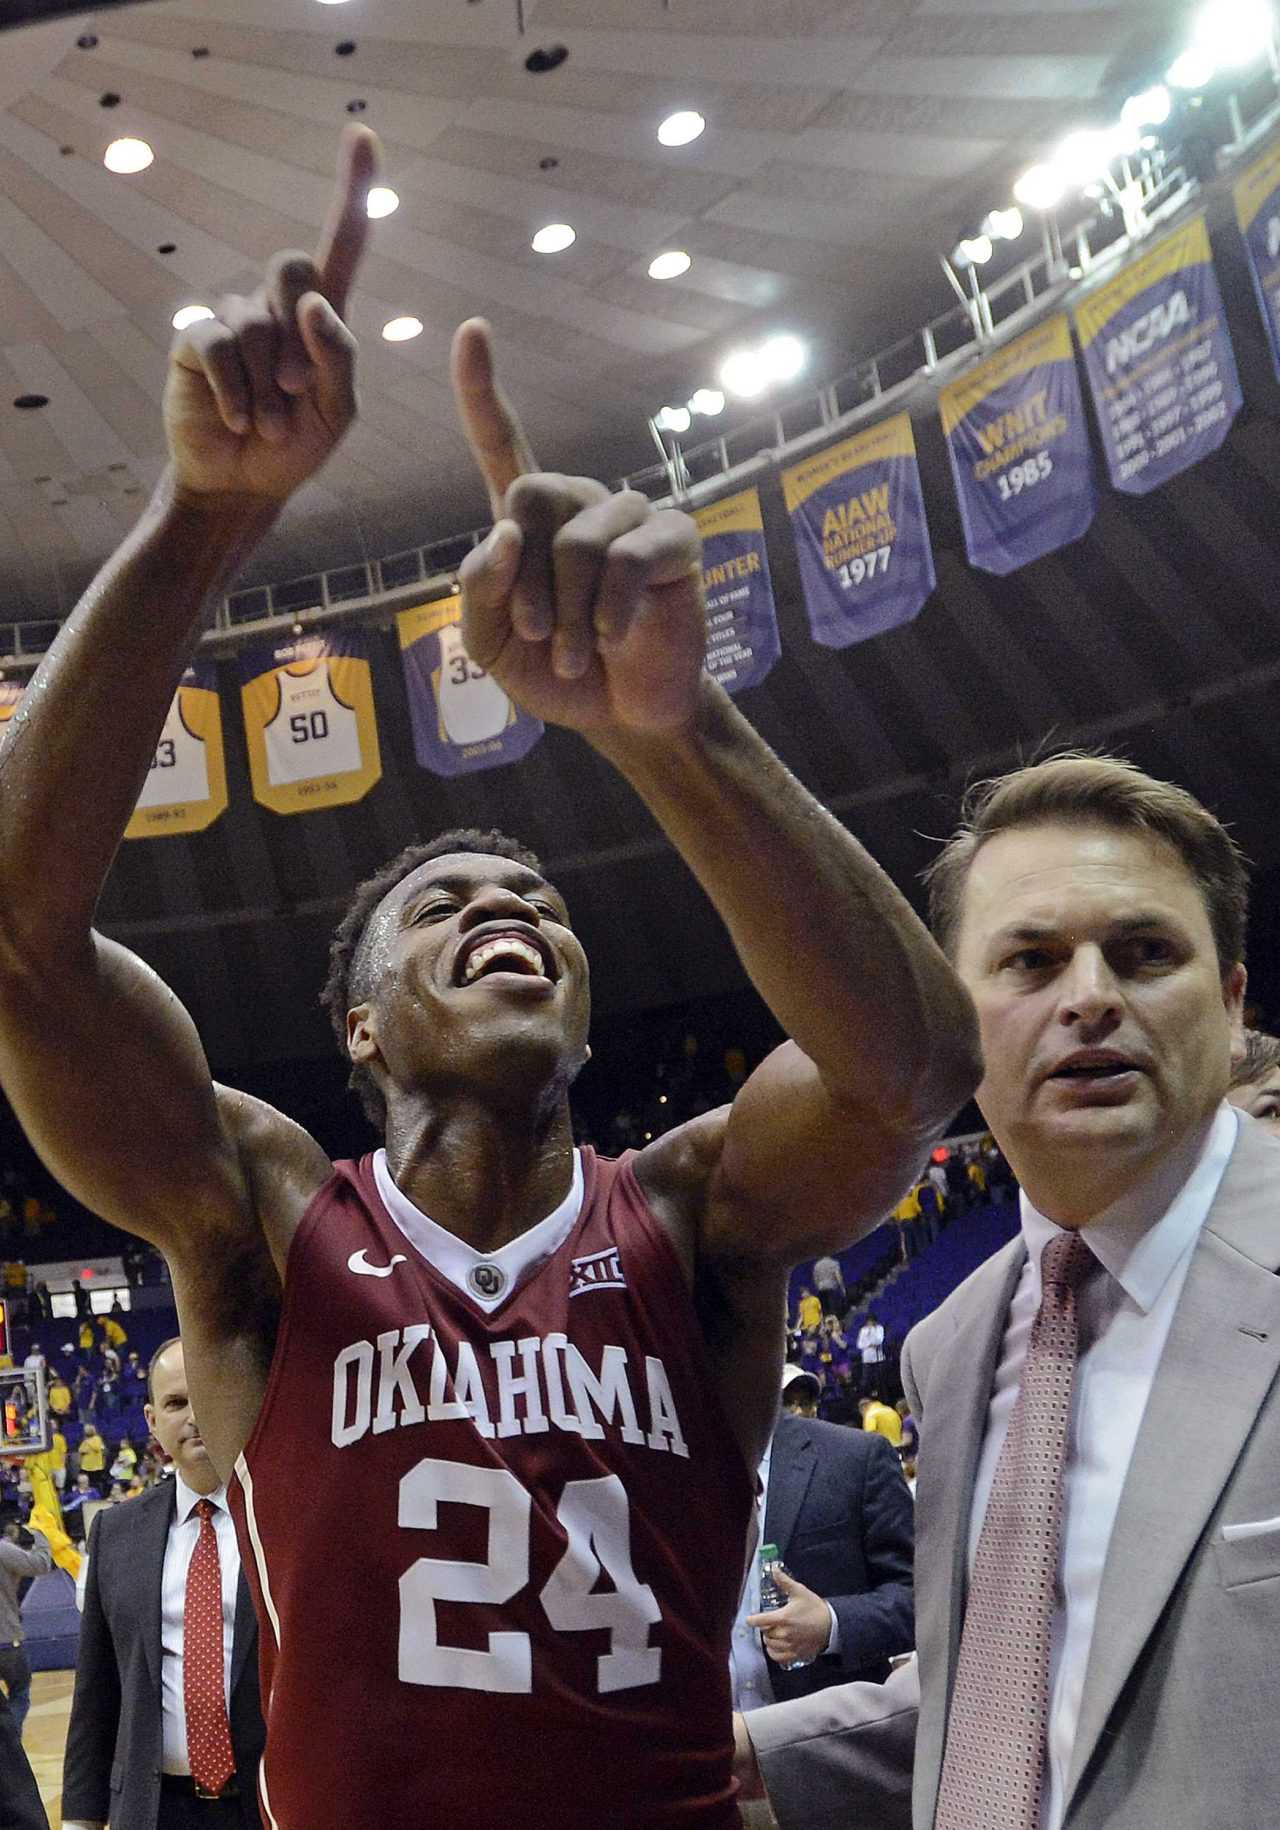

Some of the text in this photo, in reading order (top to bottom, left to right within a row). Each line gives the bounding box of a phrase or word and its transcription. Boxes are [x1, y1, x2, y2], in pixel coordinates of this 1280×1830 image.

[998, 450, 1052, 501] 1985
[824, 483, 889, 536] AIAW
[703, 552, 761, 589] UNTER
[839, 545, 891, 589] 1977
[290, 711, 329, 743] 50
[331, 1324, 690, 1459] OKLAHOMA
[398, 1458, 663, 1694] 24
